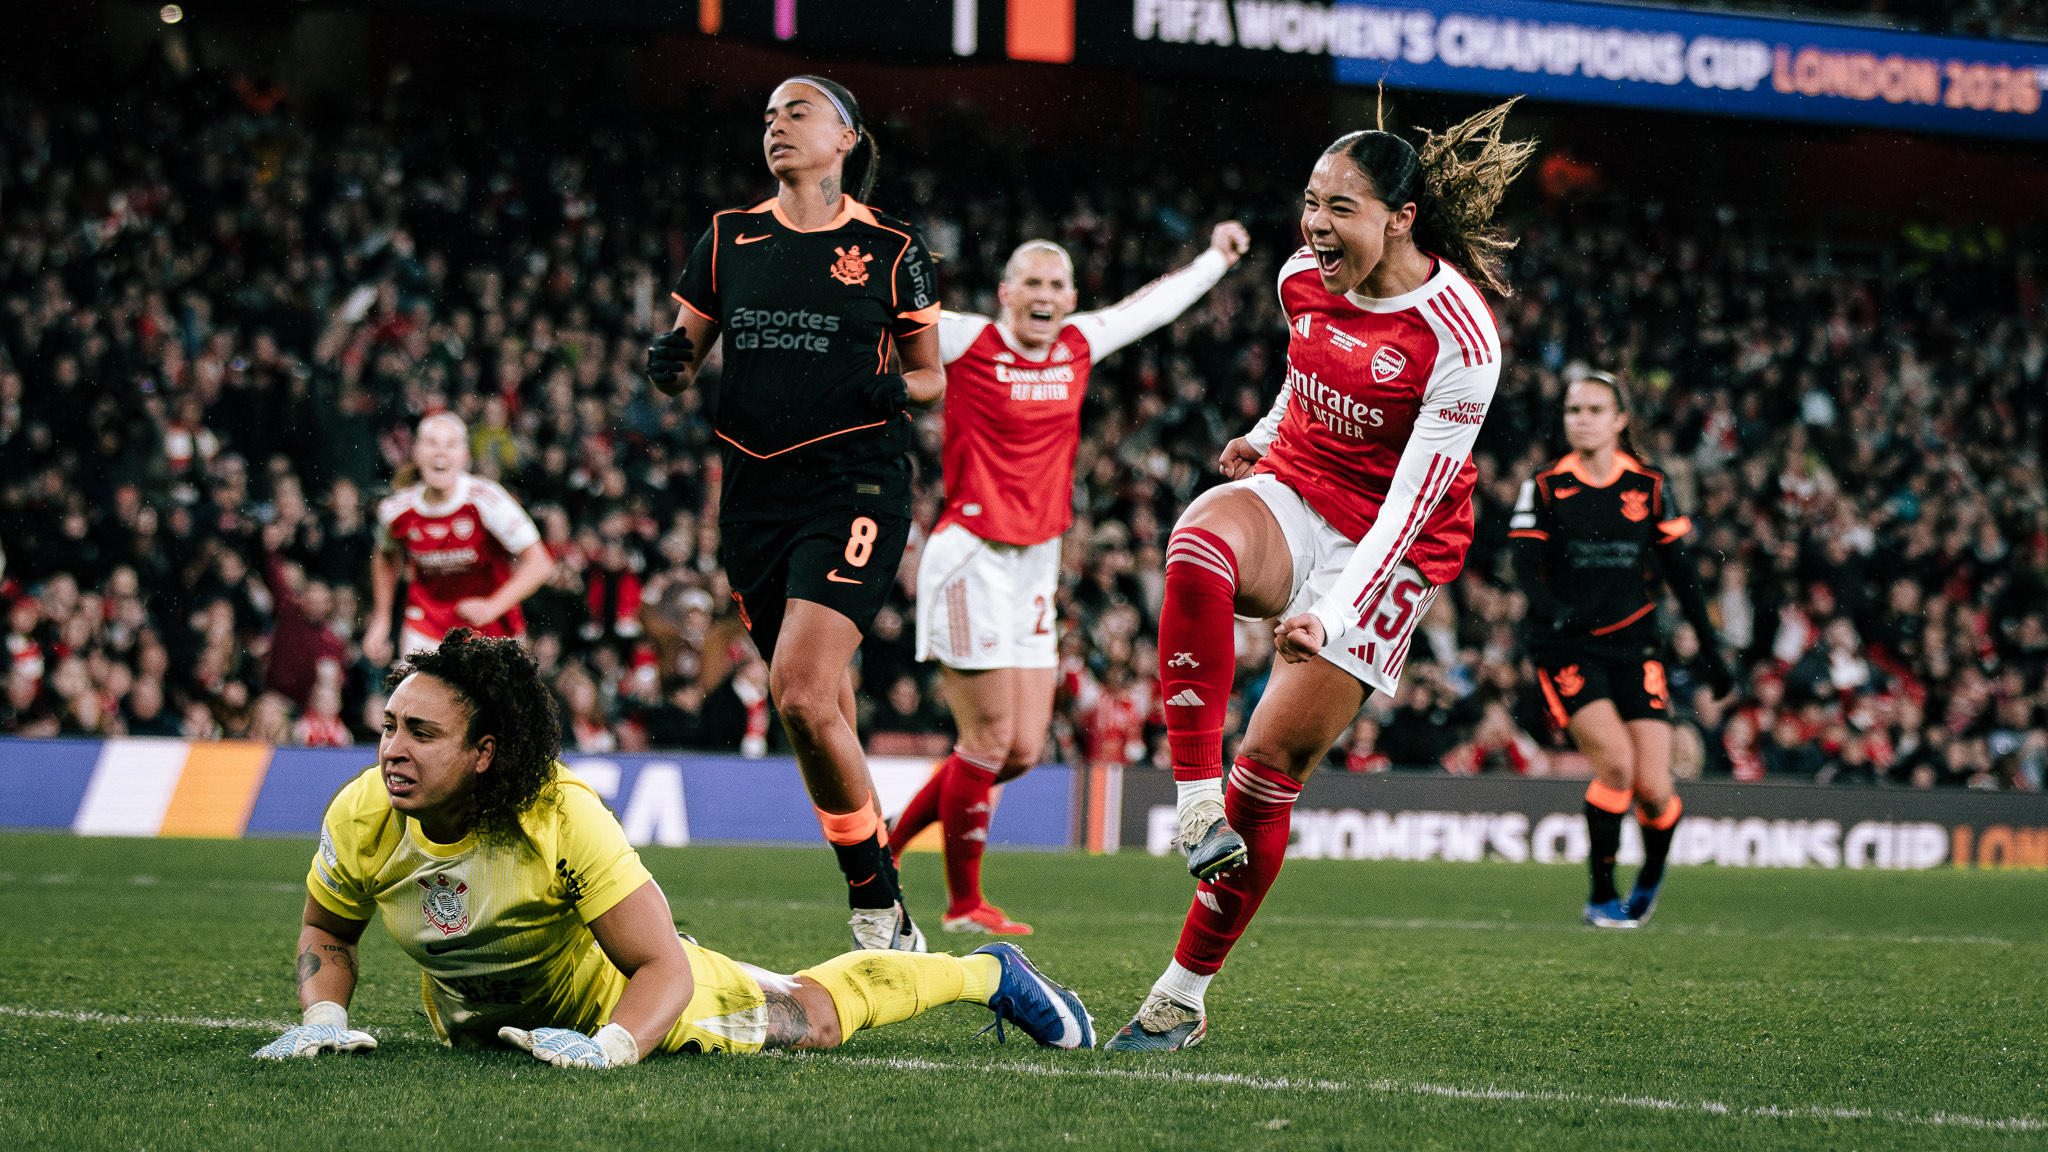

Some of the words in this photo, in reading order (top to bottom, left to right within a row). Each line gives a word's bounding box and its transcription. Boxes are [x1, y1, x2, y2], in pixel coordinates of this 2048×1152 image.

[1133, 0, 1234, 46] FIFA
[1686, 34, 1772, 92] CUP
[1772, 44, 1940, 106] LONDON
[908, 260, 930, 310] bmg
[730, 307, 841, 332] Esportes
[1312, 404, 1364, 440] BETTER
[1456, 400, 1486, 413] VISIT
[845, 517, 878, 567] 8
[1356, 572, 1425, 643] 15
[1844, 820, 1949, 870] CUP
